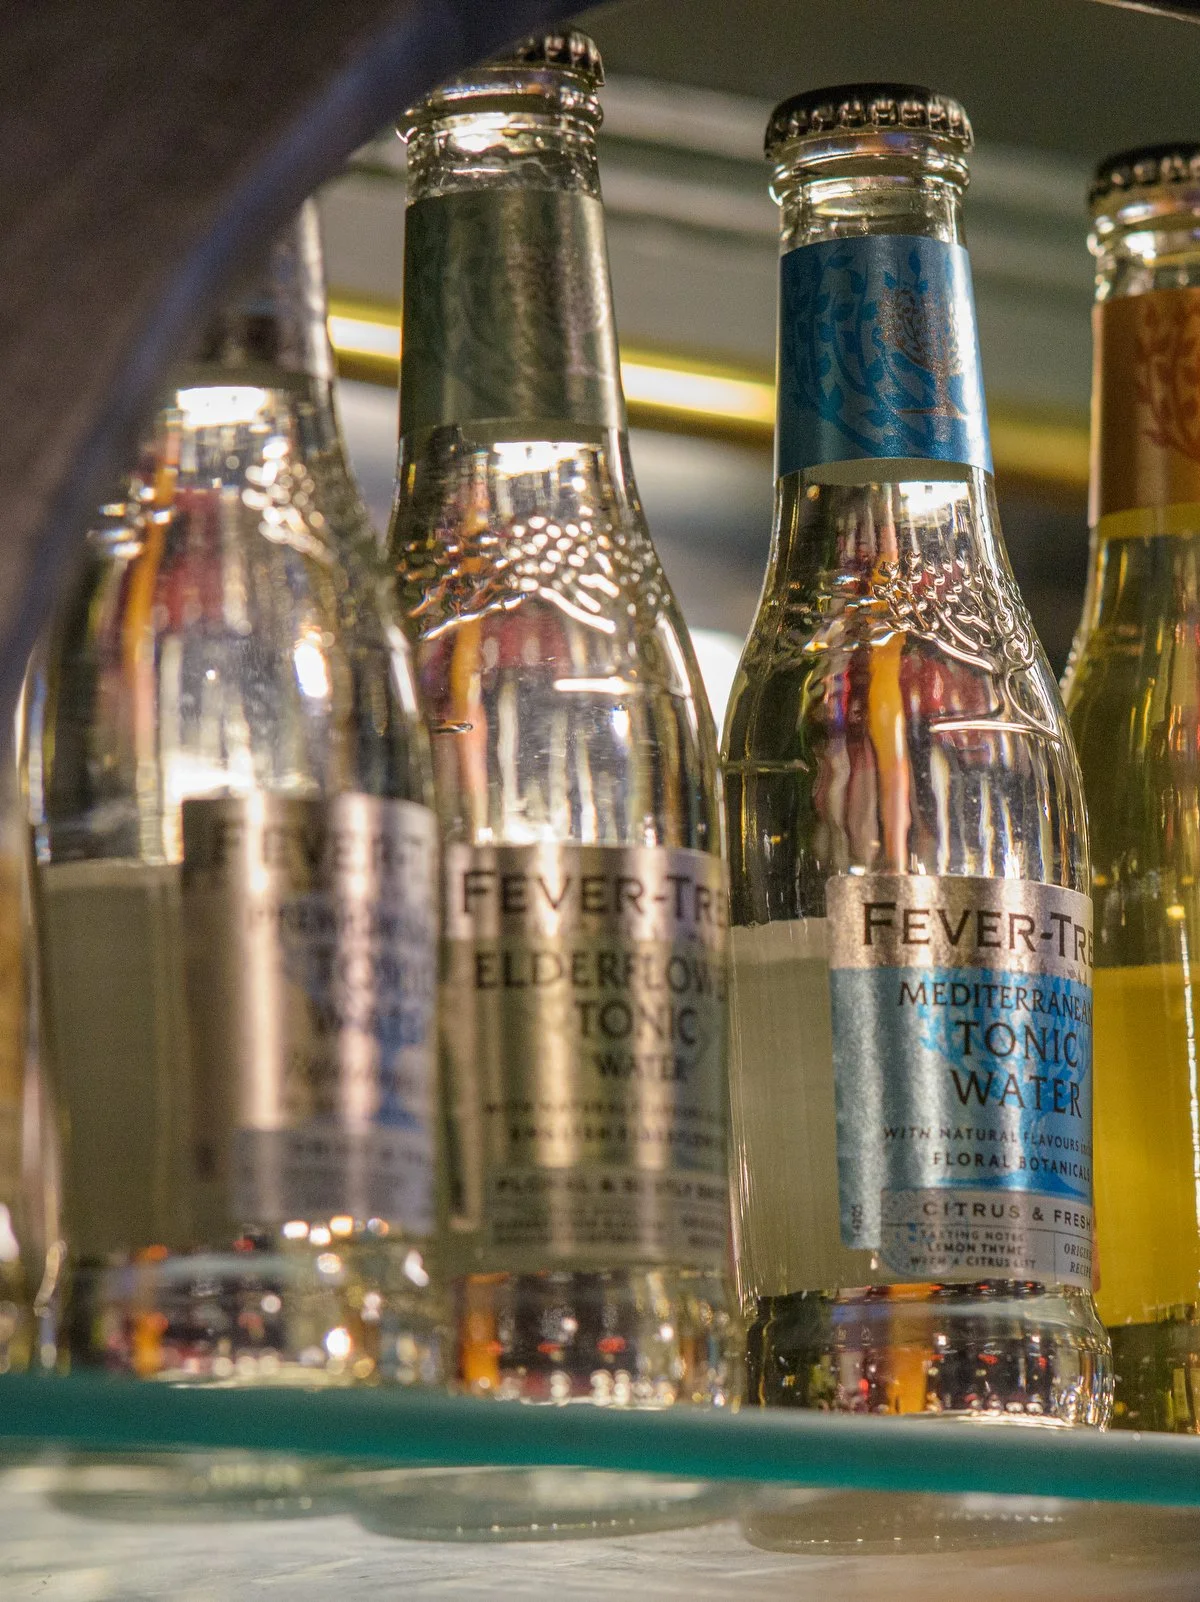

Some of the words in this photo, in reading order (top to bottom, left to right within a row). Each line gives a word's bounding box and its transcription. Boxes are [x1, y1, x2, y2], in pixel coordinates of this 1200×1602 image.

[577, 1000, 697, 1046] TONIC
[955, 1020, 1079, 1069] TONIC
[951, 1069, 1082, 1120] WATER
[884, 1126, 931, 1141] WITH
[939, 1126, 1018, 1143] NATURAL
[1023, 1132, 1080, 1152] FLAVOURS
[932, 1152, 1010, 1169] FLORAL
[1019, 1157, 1091, 1183] BOTANICALS
[922, 1202, 1021, 1219] CITRUS
[1031, 1206, 1045, 1222] &
[1053, 1208, 1091, 1231] FRESH
[965, 1256, 1012, 1268] CITRUS
